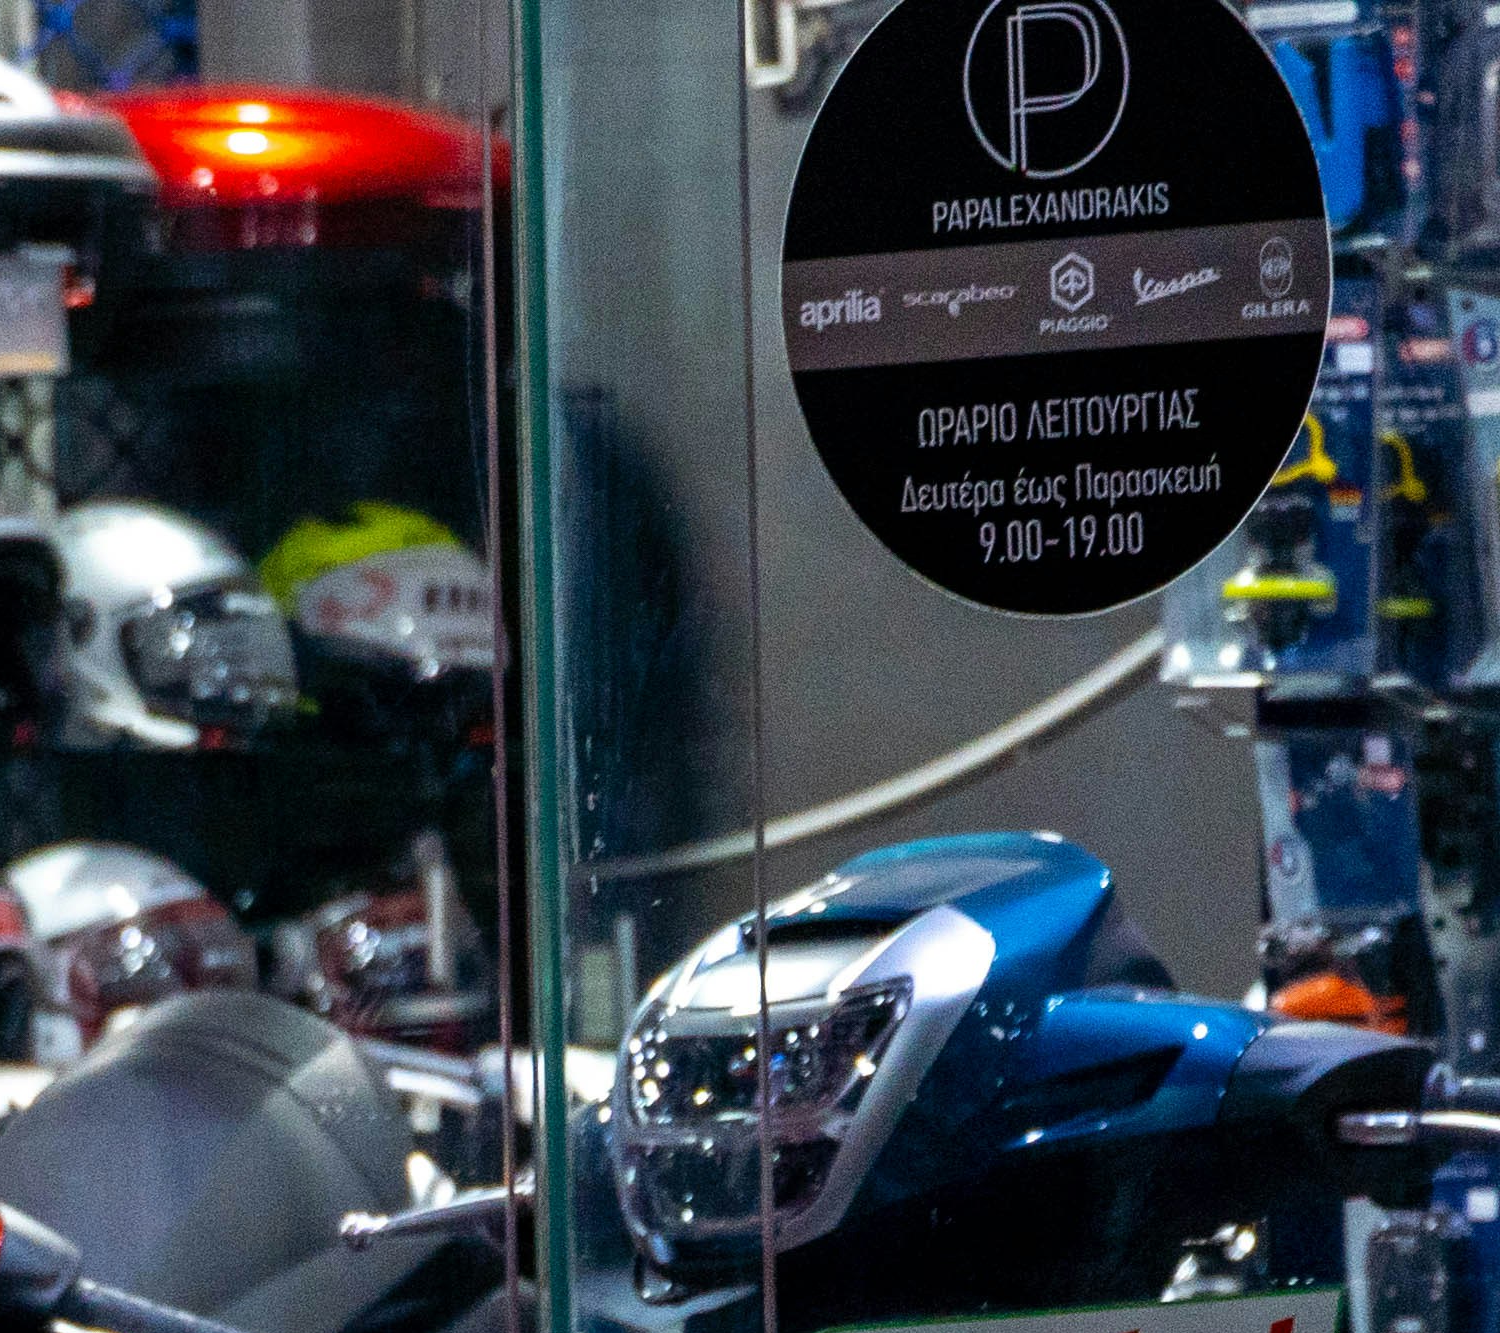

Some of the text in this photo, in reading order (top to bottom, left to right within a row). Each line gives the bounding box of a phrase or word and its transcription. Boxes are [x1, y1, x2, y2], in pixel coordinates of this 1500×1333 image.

[931, 181, 1171, 234] PAPALEXANDRAKIS
[800, 288, 883, 331] aprilia
[1133, 266, 1222, 306] Vespa
[1241, 299, 1310, 319] GILERA
[1039, 314, 1111, 335] PIAGGIO
[918, 388, 1201, 448] ΩΡΑΡΙΟ ΛΕΙΤΟΥΡΓΙΑΣ
[901, 452, 1221, 517] Δευτέρα έως Παρασκευή
[979, 511, 1145, 563] 9.00-19.00
